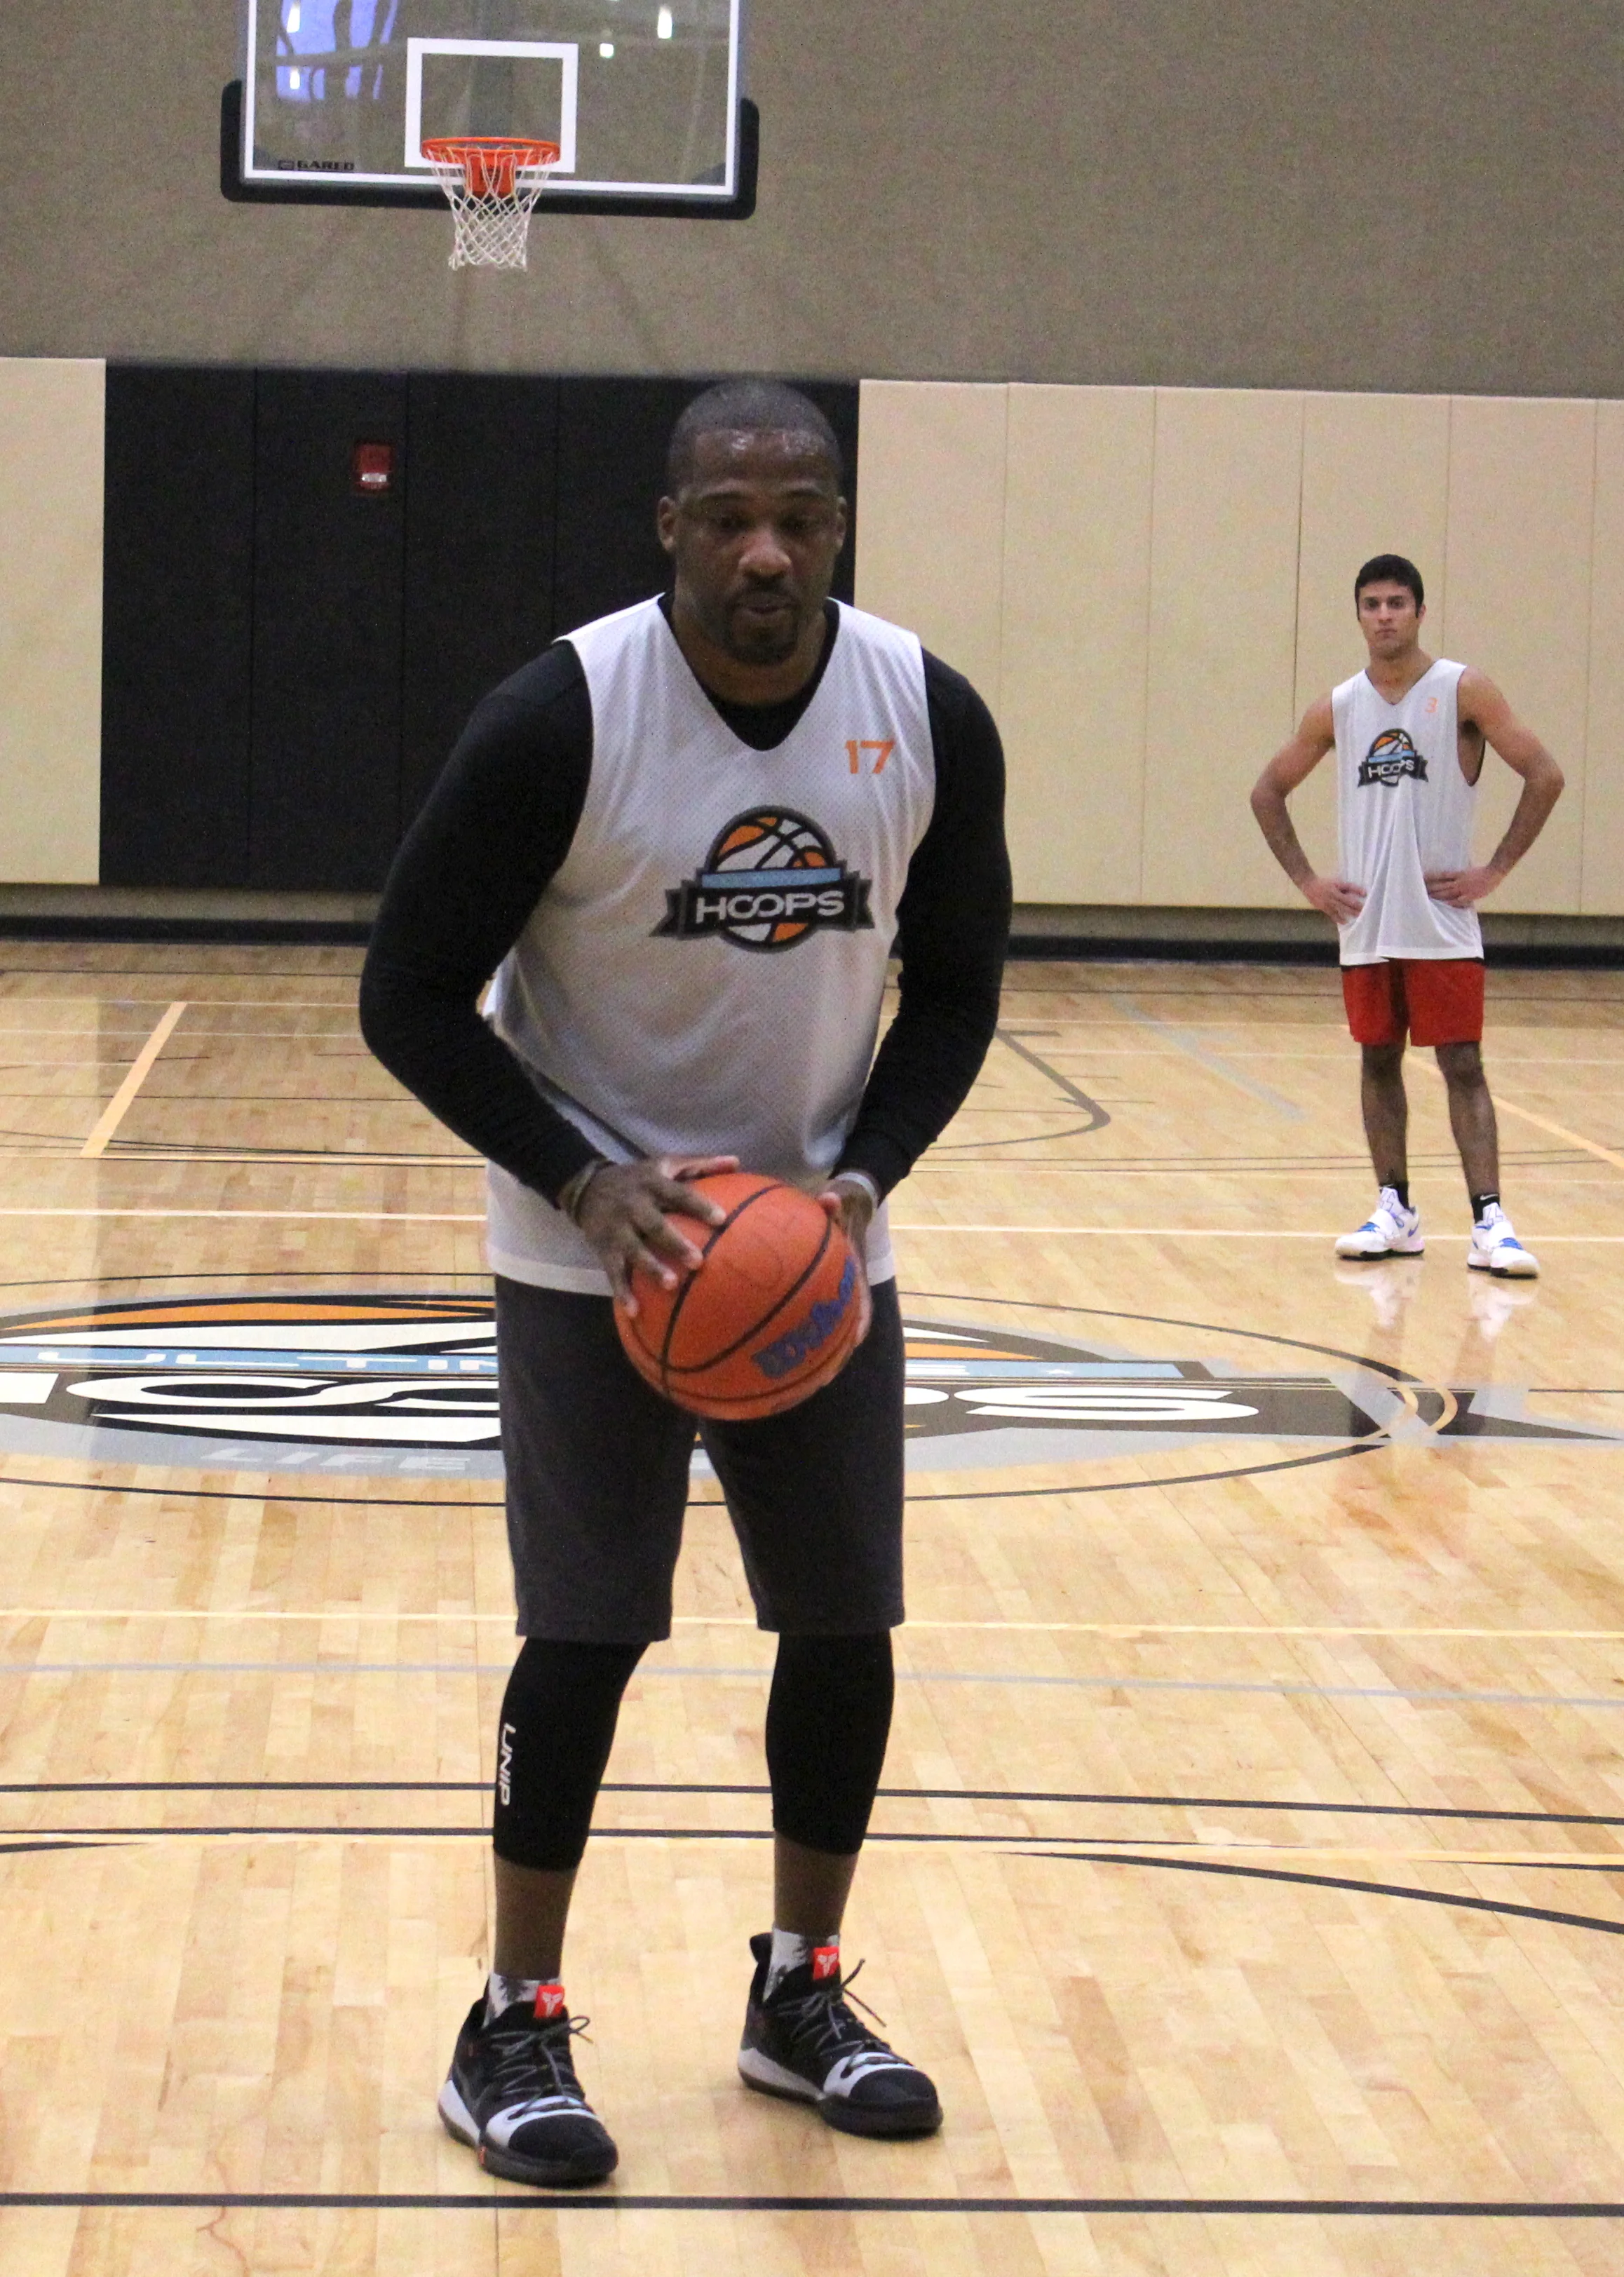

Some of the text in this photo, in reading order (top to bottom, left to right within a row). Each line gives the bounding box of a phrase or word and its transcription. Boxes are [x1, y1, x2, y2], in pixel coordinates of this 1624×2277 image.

[1425, 697, 1438, 713] 3
[844, 740, 895, 774] 17
[696, 890, 844, 924] HOOPS
[201, 1447, 471, 1471] LIFE
